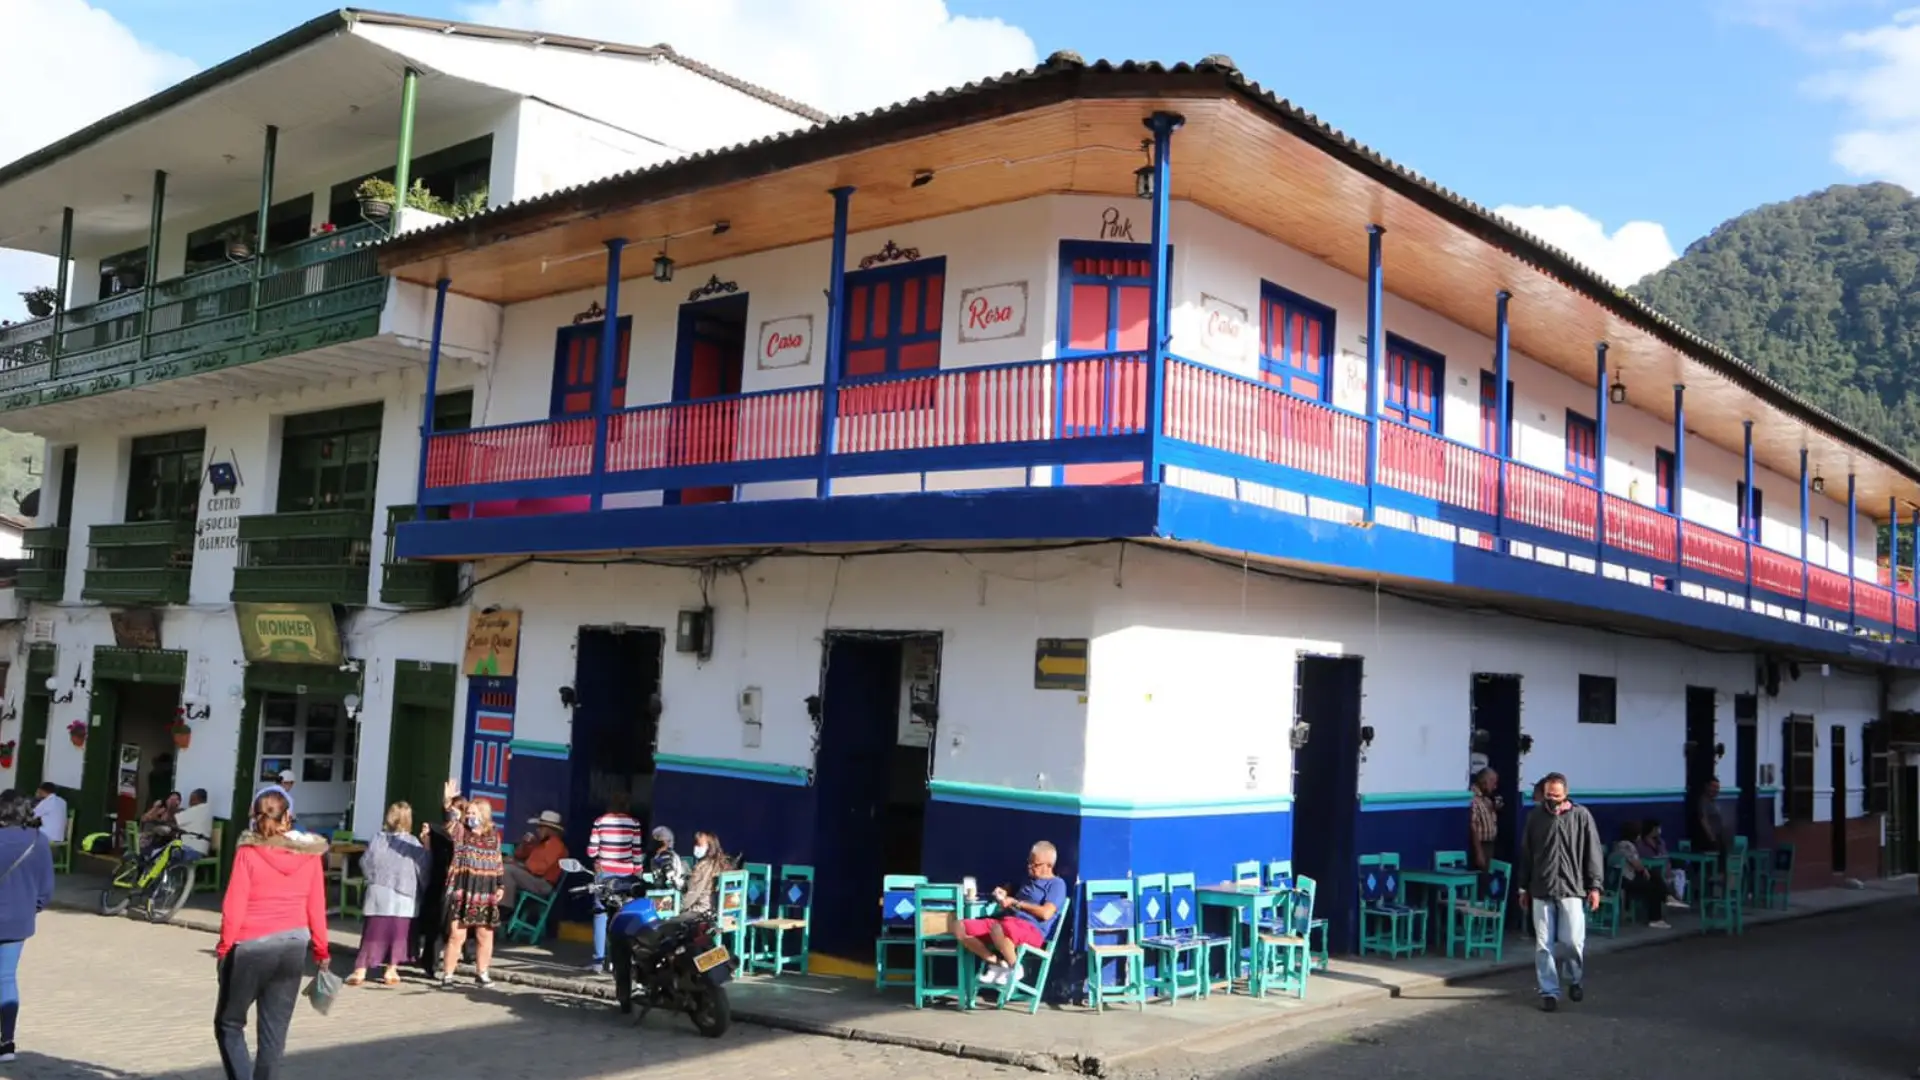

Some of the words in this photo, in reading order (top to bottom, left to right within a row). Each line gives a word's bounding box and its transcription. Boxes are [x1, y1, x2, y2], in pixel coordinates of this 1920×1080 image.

[1100, 206, 1135, 242] Pink
[968, 295, 1014, 331] Rosa
[766, 331, 804, 359] Casa
[207, 497, 241, 512] CENTRO
[258, 619, 314, 637] MONHER
